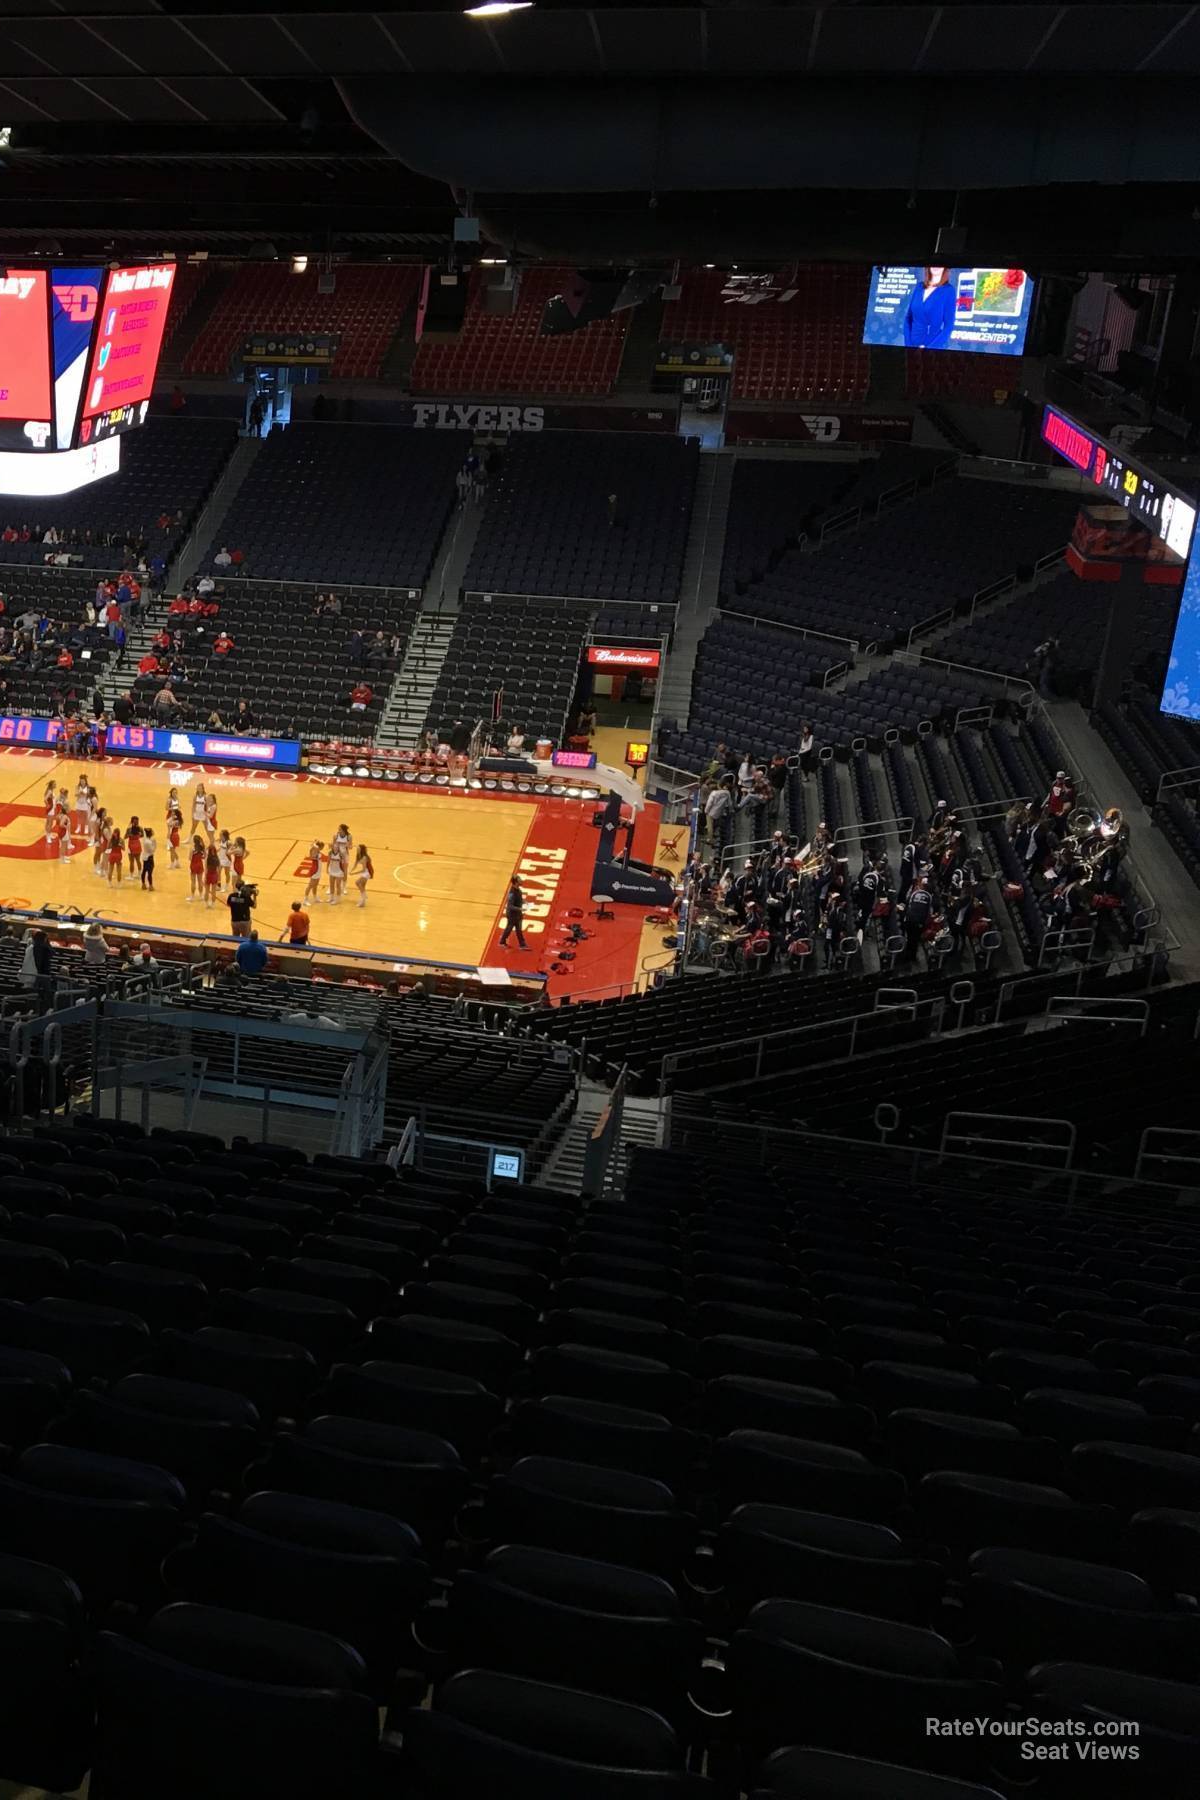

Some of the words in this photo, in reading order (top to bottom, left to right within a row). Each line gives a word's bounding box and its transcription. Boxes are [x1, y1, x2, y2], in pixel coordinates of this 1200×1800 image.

[412, 403, 545, 432] FLYERS
[593, 649, 653, 665] Budweiser
[0, 719, 32, 740] GO
[46, 720, 155, 749] FRS!
[150, 761, 332, 785] DAYTON
[39, 903, 119, 919] PNC
[497, 1161, 515, 1171] 217
